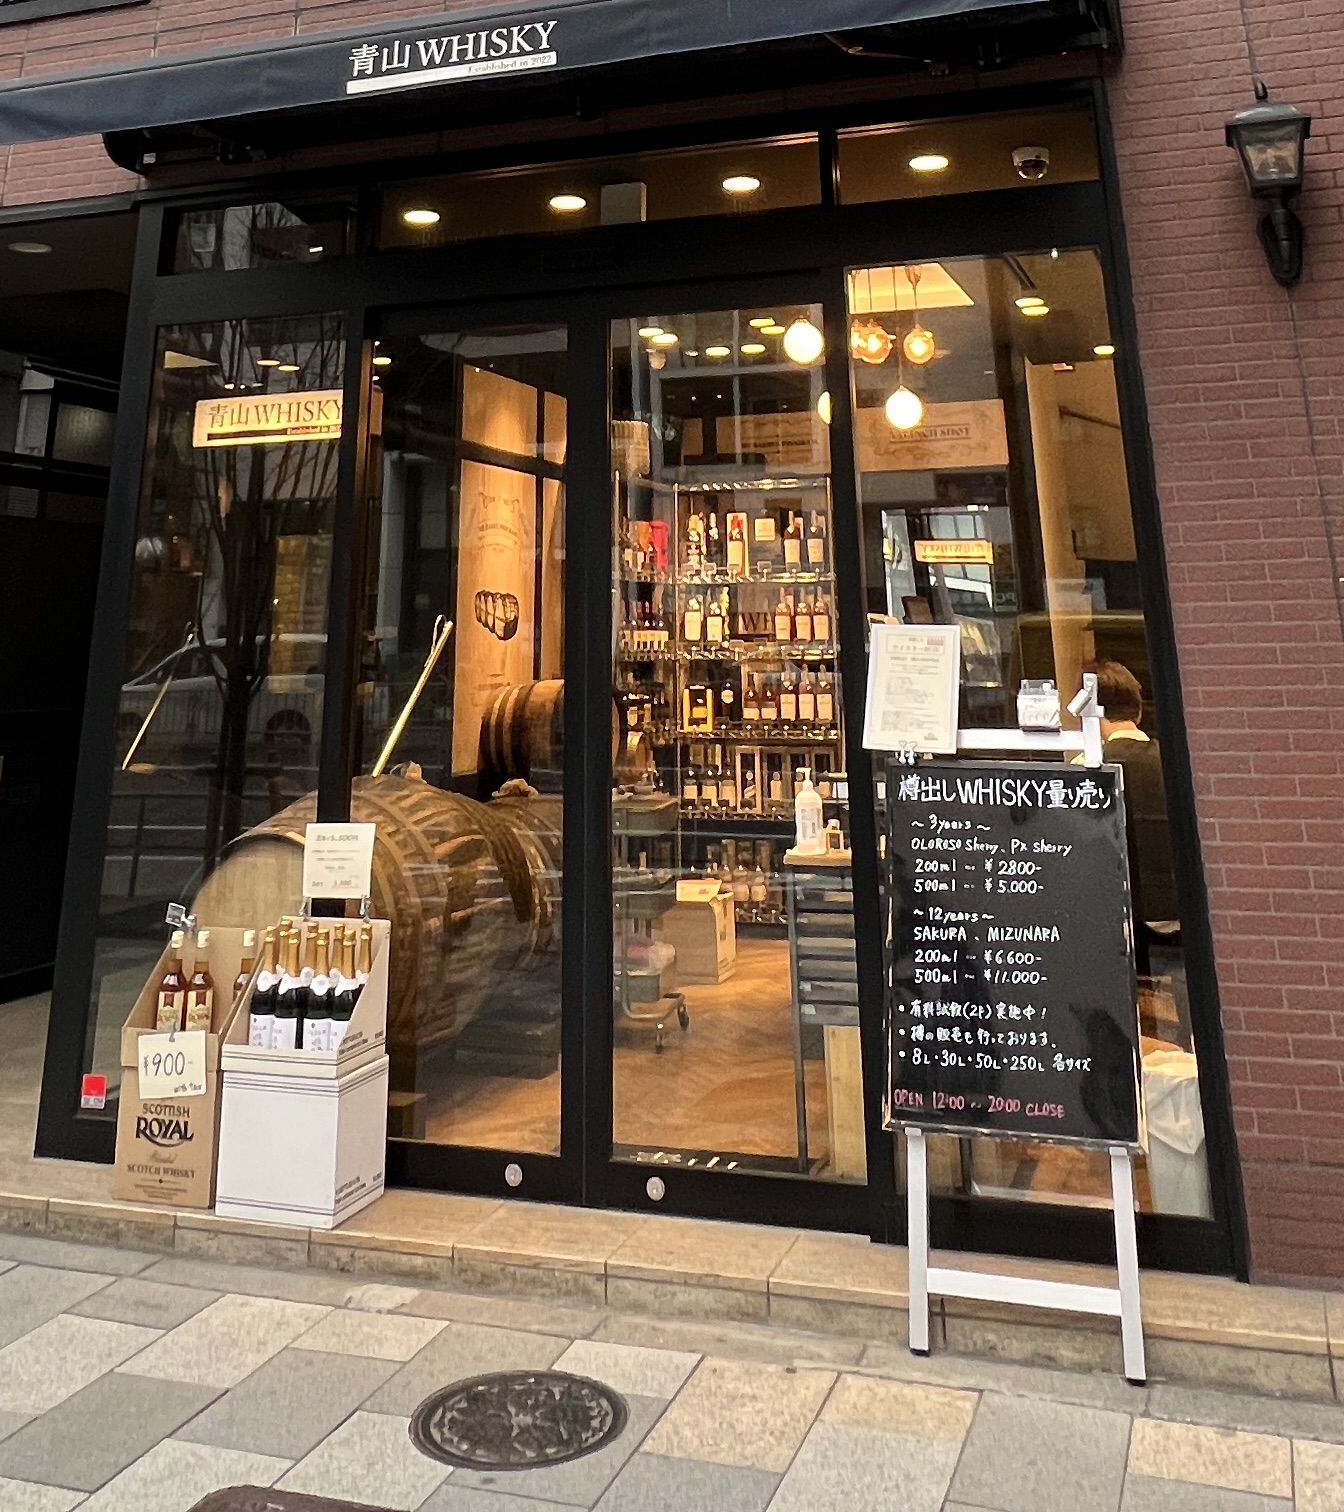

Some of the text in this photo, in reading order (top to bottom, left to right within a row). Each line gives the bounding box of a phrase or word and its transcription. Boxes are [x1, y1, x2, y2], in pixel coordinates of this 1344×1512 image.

[468, 60, 516, 73] Established
[914, 858, 956, 873] 200ml
[913, 878, 956, 893] 500ml
[988, 925, 1061, 942] MIZUNARA
[914, 949, 958, 964] 200ml
[914, 968, 958, 984] 500ml
[142, 1103, 190, 1119] SCOTTISH
[894, 1089, 924, 1107] OPEN
[1025, 1103, 1065, 1118] CLOSE
[135, 1116, 194, 1146] ROYAL
